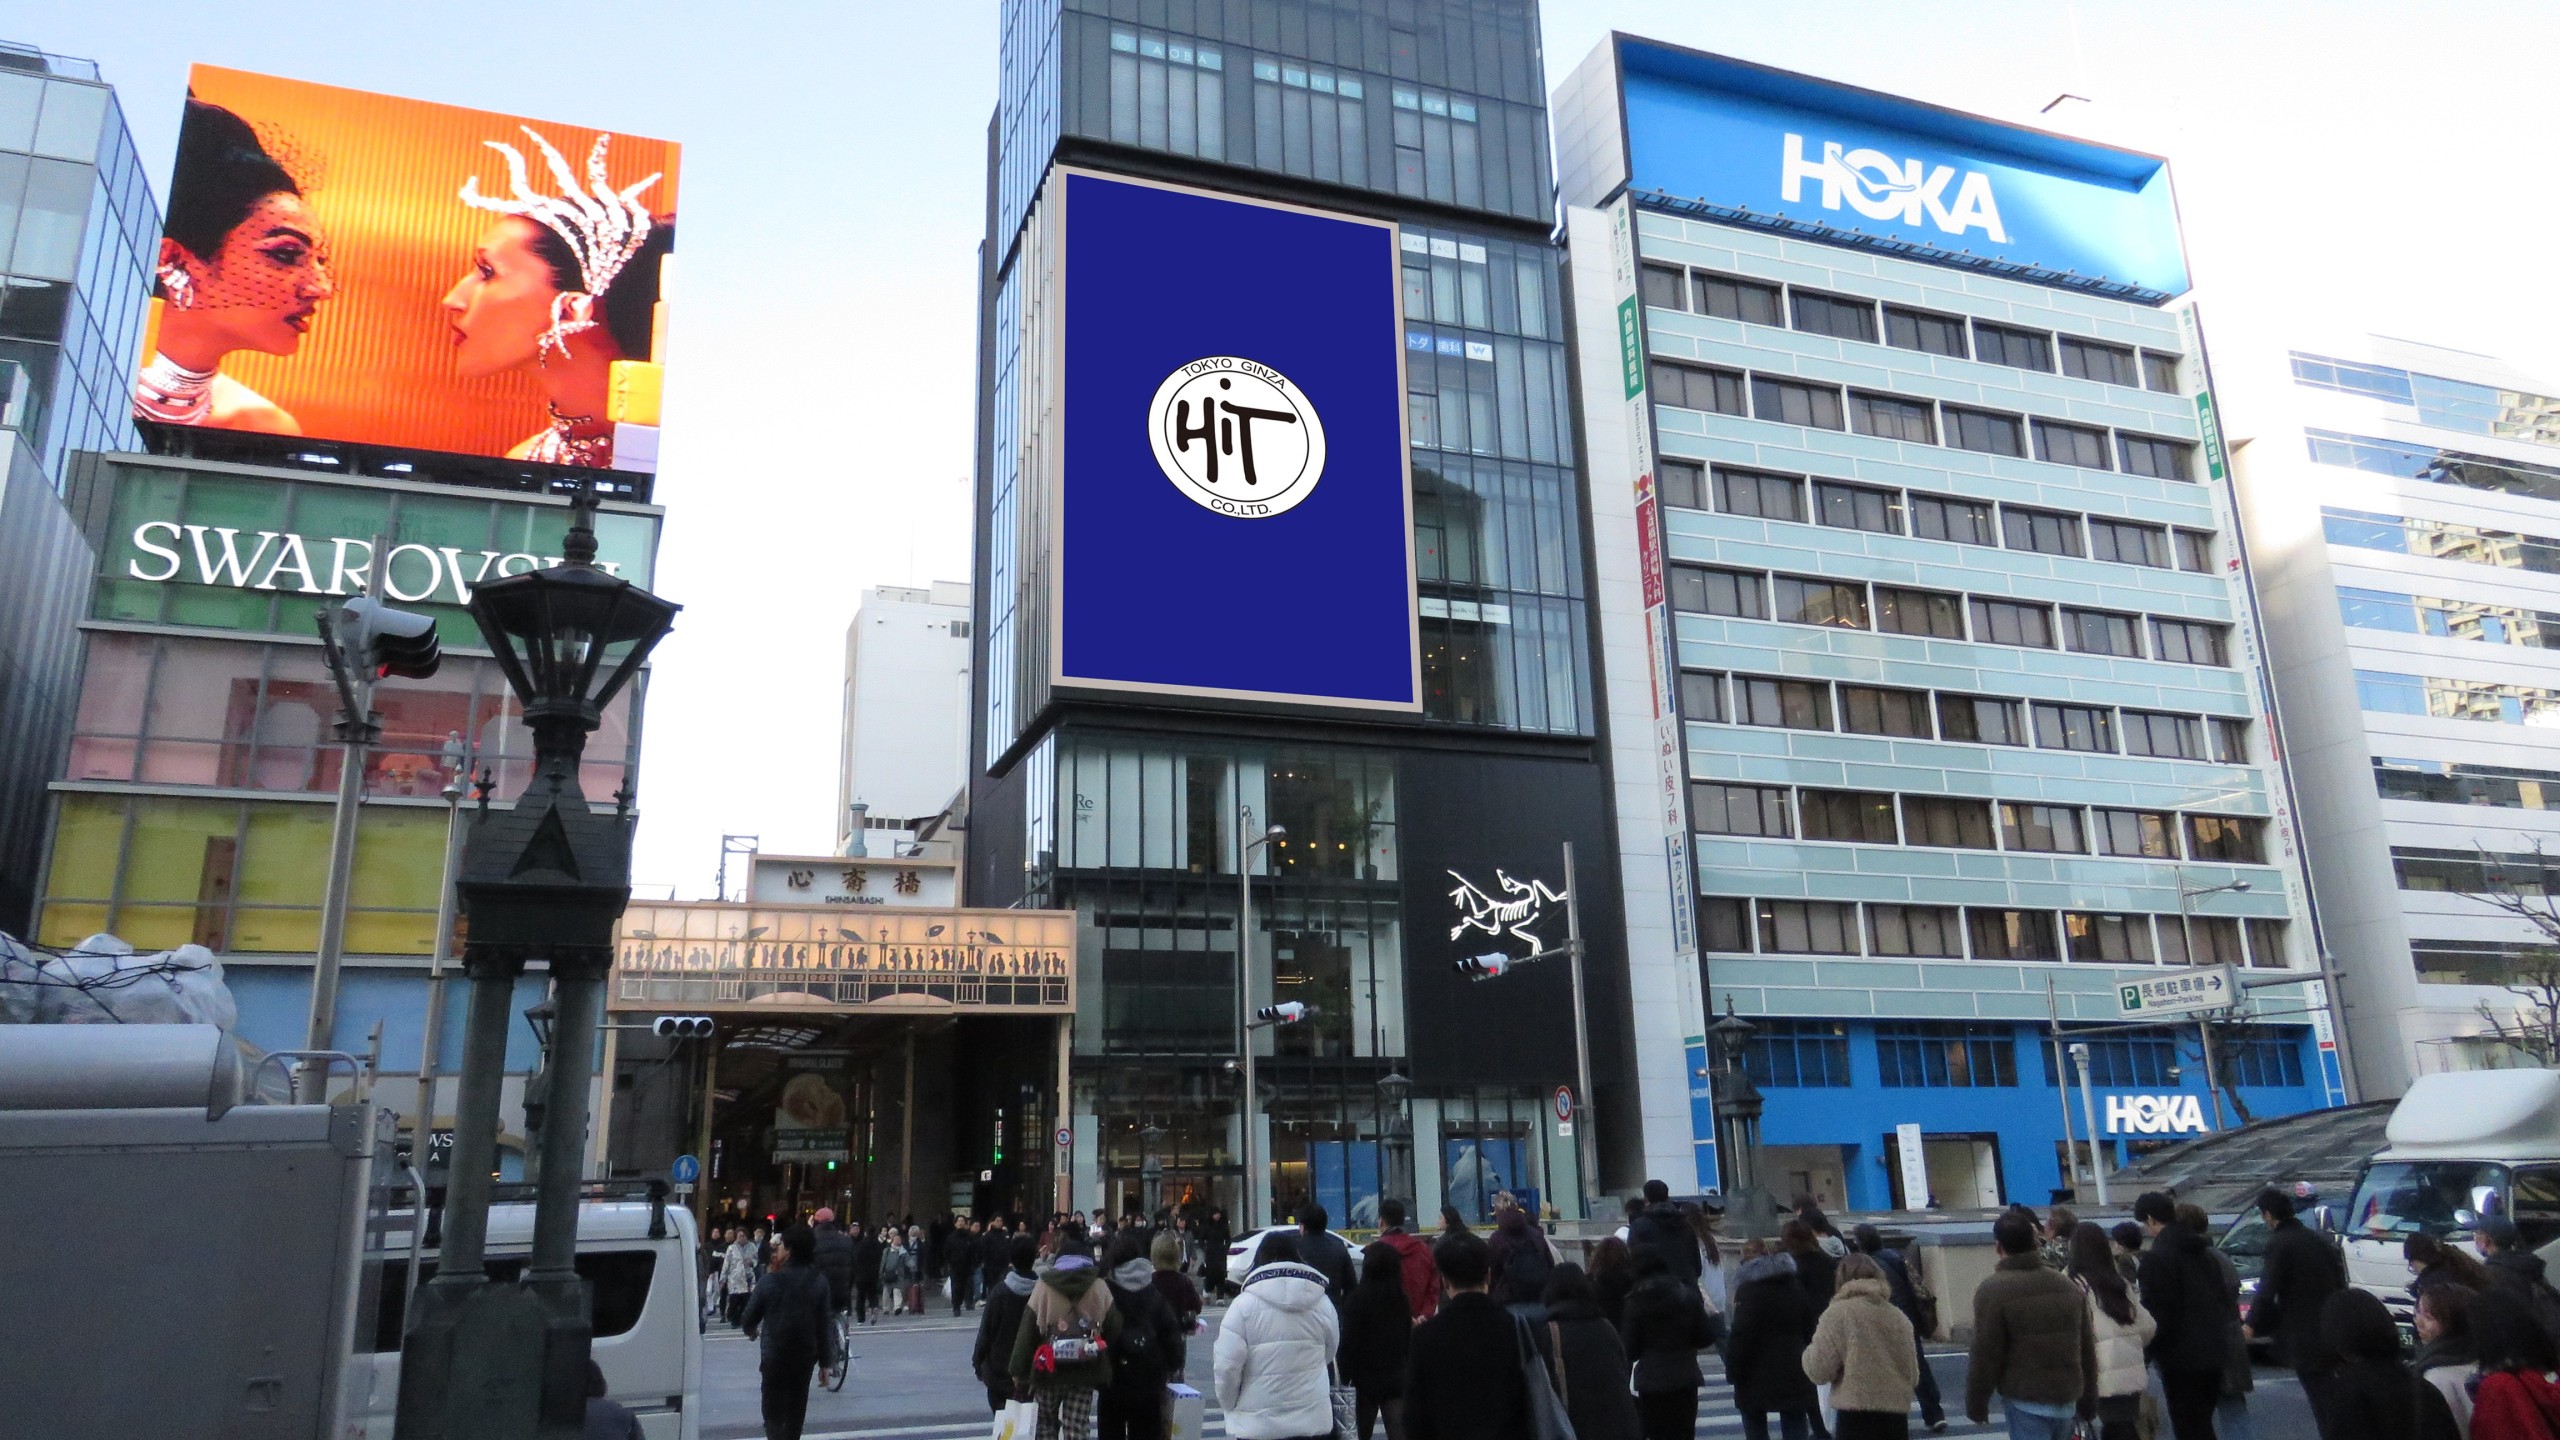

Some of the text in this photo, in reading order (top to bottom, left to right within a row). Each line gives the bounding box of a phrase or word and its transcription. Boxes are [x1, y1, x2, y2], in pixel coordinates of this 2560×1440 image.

[1153, 45, 1207, 65] AOBA
[1781, 132, 2007, 244] HOKA
[1181, 358, 1286, 389] TOKYO GINZA
[1211, 498, 1272, 516] CO.,LTD.
[129, 521, 621, 606] SWAROVS
[1661, 725, 1678, 827] いぬい皮フ科
[788, 867, 921, 894] 心斎橋
[825, 895, 884, 905] SHINSAIBASHI
[2124, 988, 2136, 1008] P
[2141, 976, 2205, 998] 長堀駐車場
[2106, 1095, 2207, 1134] HOKA
